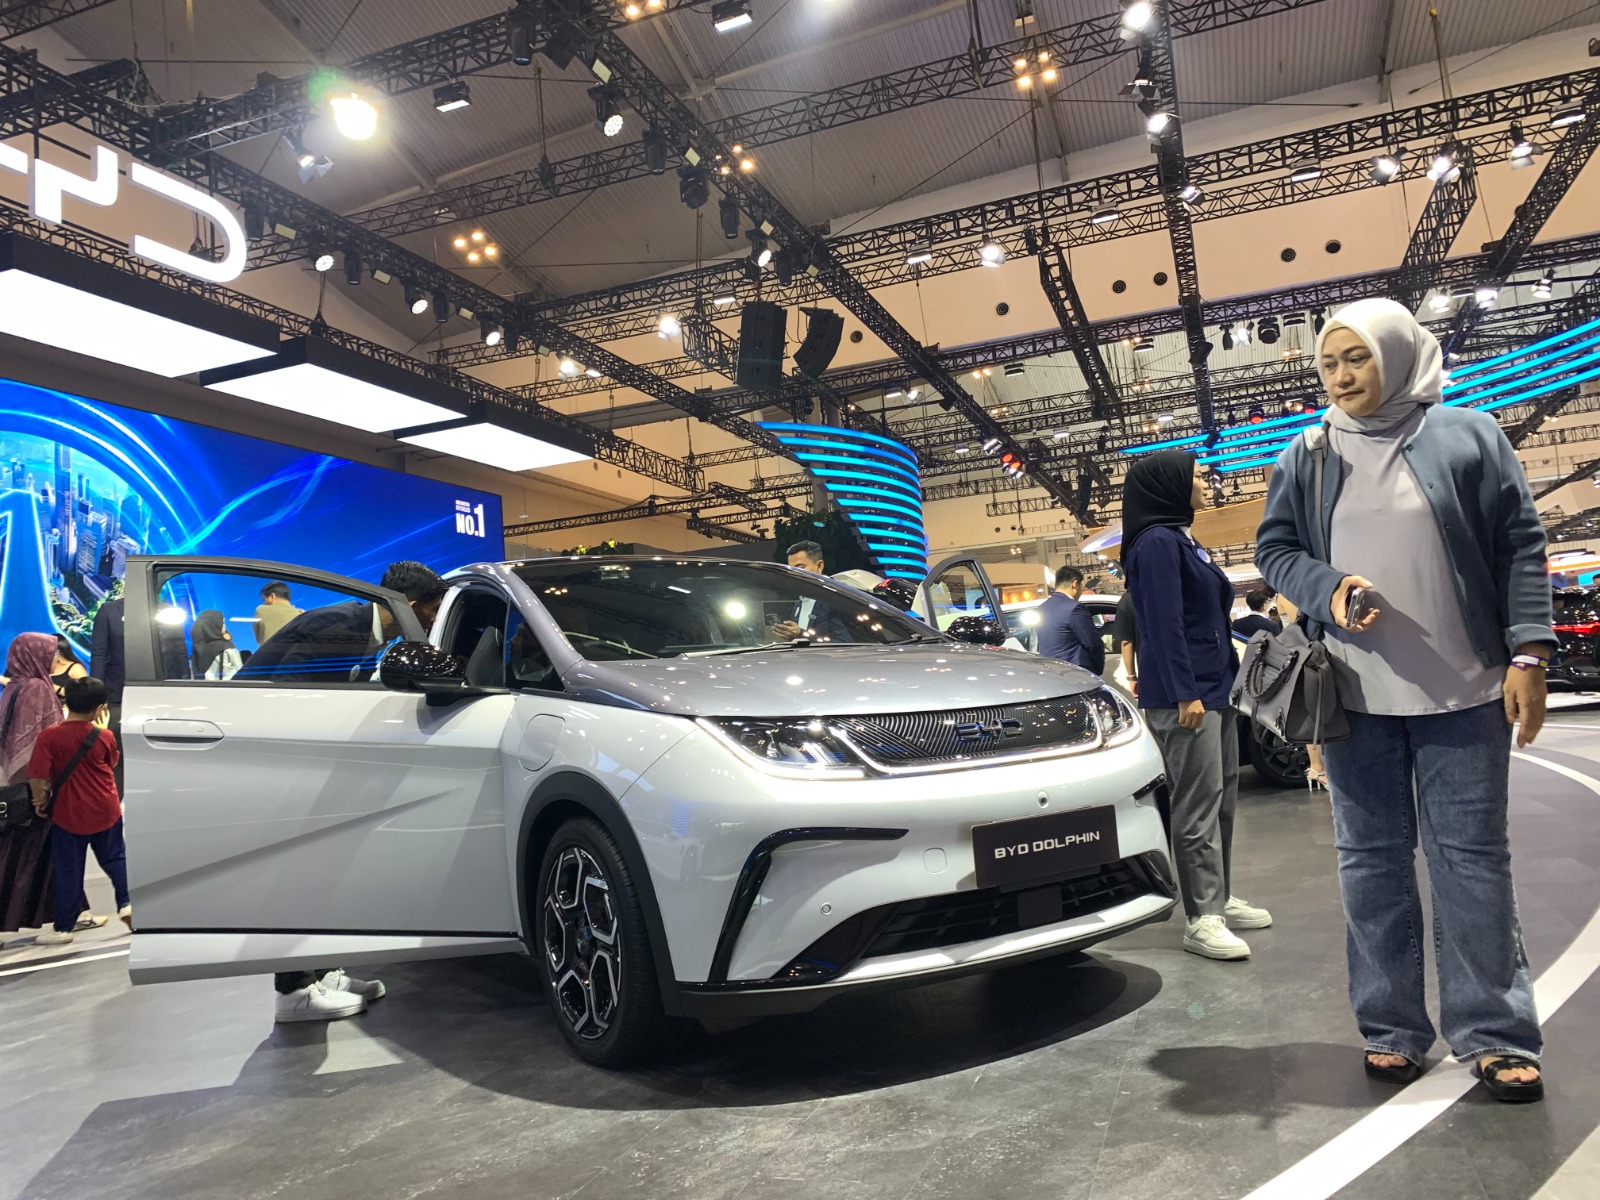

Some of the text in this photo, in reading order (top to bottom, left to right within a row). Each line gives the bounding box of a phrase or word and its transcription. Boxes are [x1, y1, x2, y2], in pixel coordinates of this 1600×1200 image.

[0, 143, 247, 283] YD
[994, 831, 1100, 859] BYD DOLPHIN
